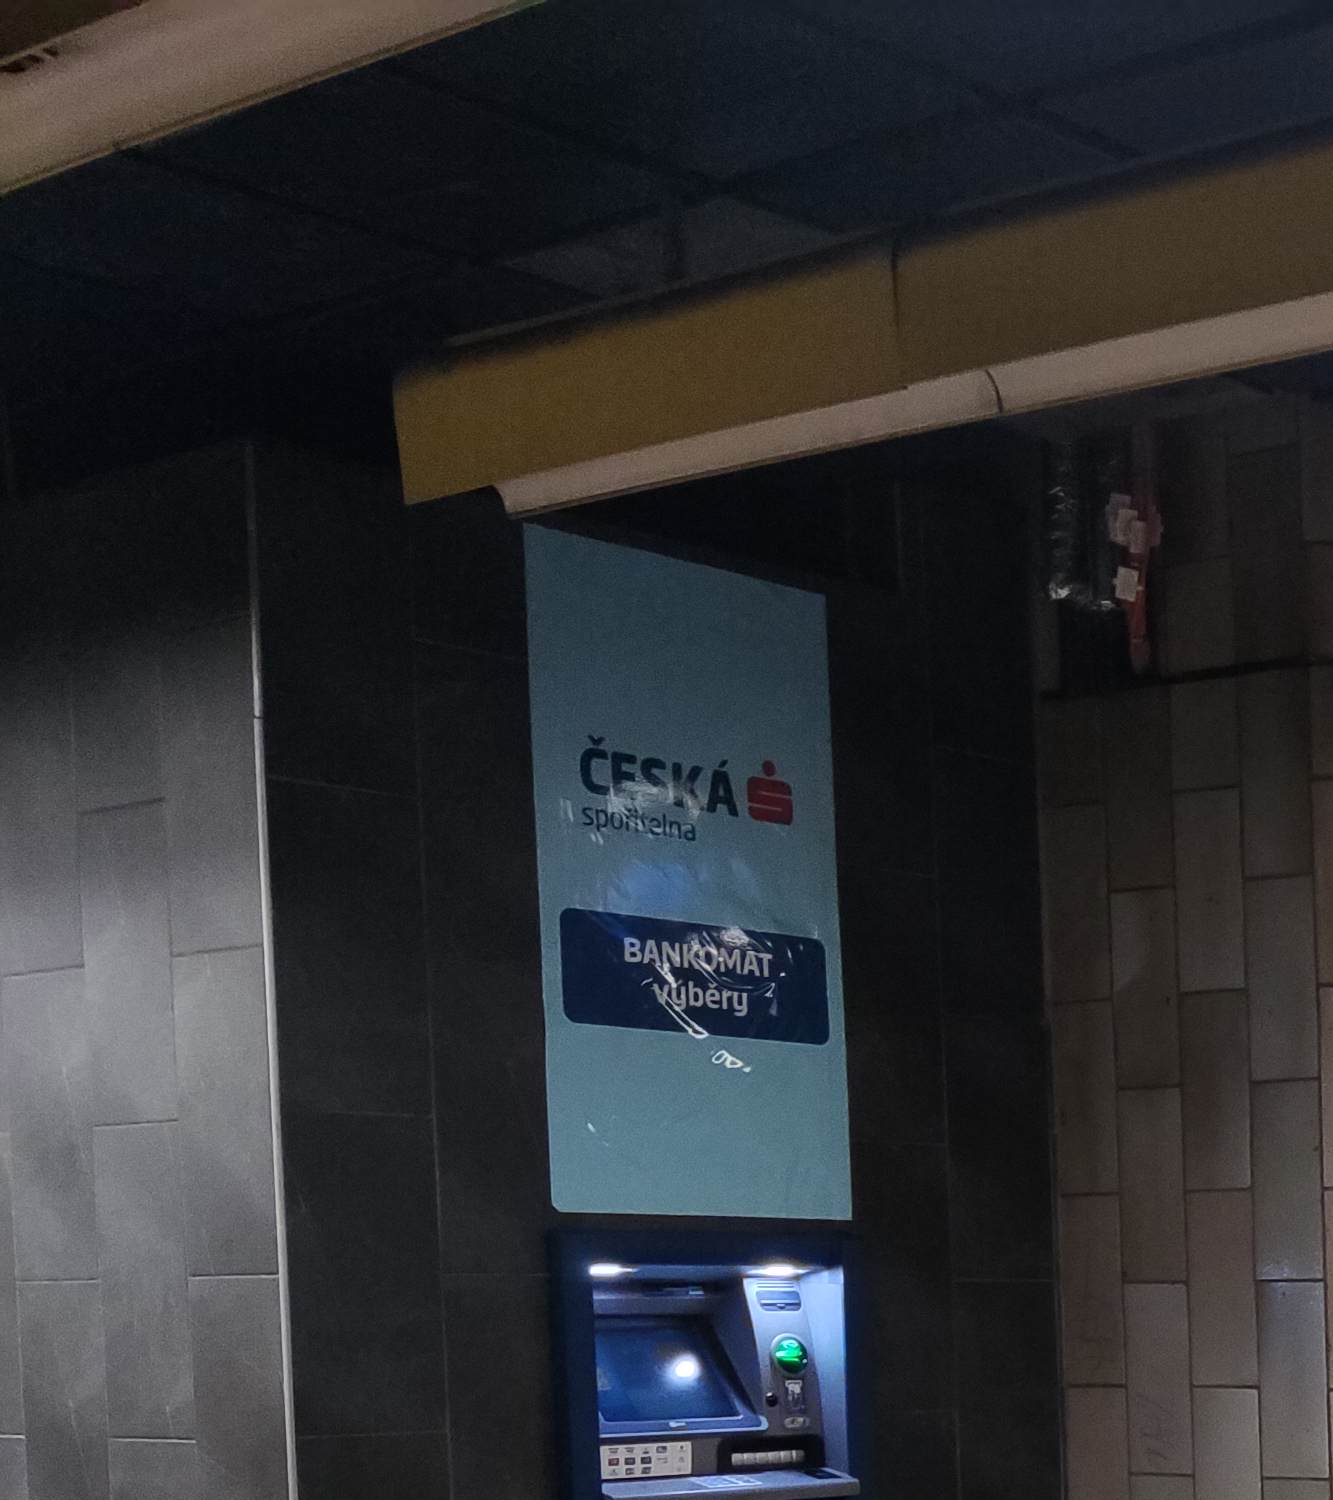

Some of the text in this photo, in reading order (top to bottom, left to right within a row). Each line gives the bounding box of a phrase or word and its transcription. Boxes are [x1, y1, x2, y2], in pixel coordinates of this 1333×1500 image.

[579, 735, 739, 817] ČESKÁ
[582, 805, 696, 841] spořitelna
[623, 937, 773, 978] BANKOMAT
[653, 978, 748, 1017] výběry
